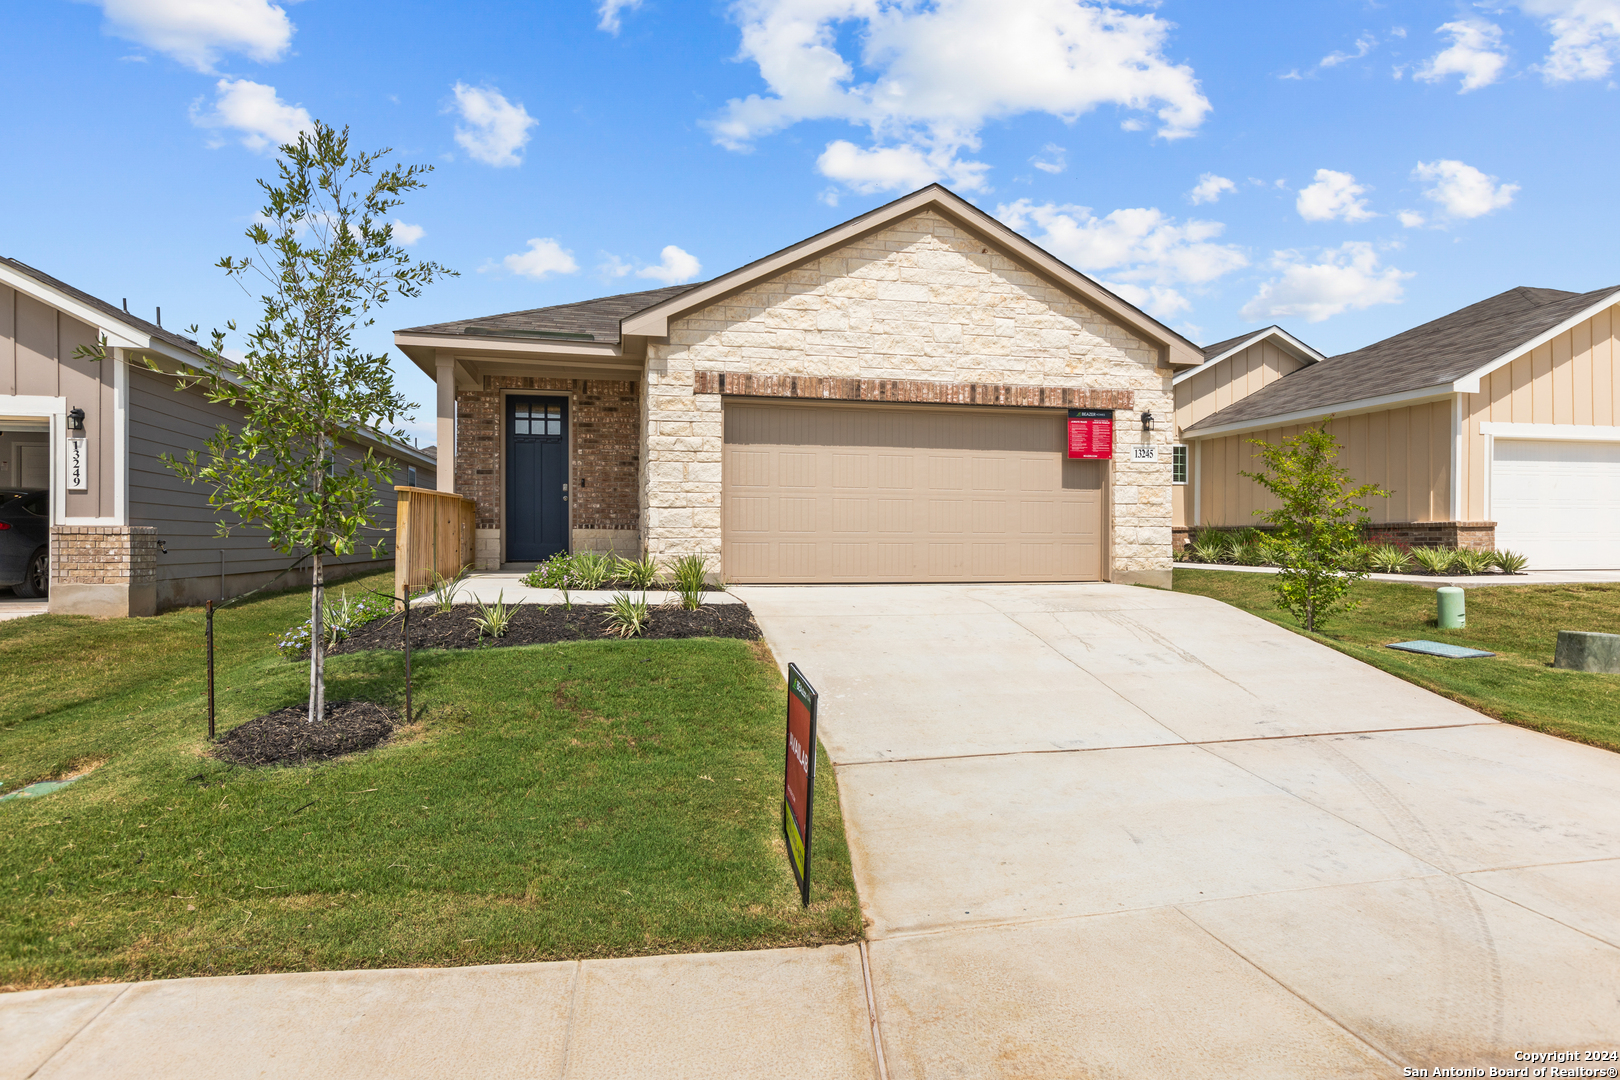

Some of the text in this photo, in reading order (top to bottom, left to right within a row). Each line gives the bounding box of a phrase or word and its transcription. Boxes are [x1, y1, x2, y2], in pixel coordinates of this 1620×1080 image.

[72, 440, 81, 487] 13249
[1134, 449, 1154, 459] 13245
[789, 731, 809, 774] AVAILAB
